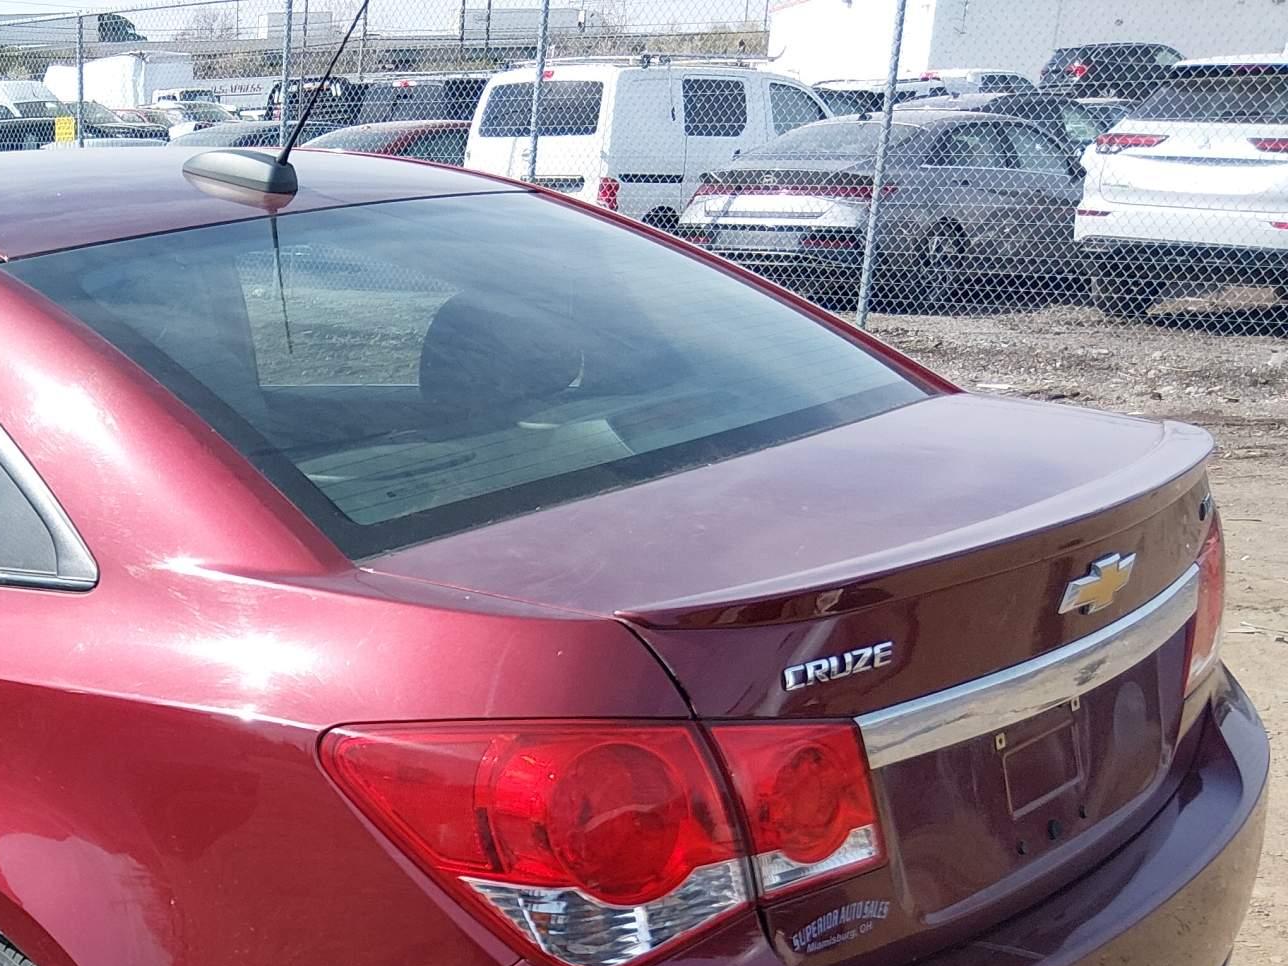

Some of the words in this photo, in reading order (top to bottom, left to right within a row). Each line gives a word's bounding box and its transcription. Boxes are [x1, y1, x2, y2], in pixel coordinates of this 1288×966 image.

[782, 640, 893, 692] CRUZE
[792, 909, 839, 952] SUPERIOR
[838, 901, 864, 924] AUTO
[862, 900, 890, 919] SALES
